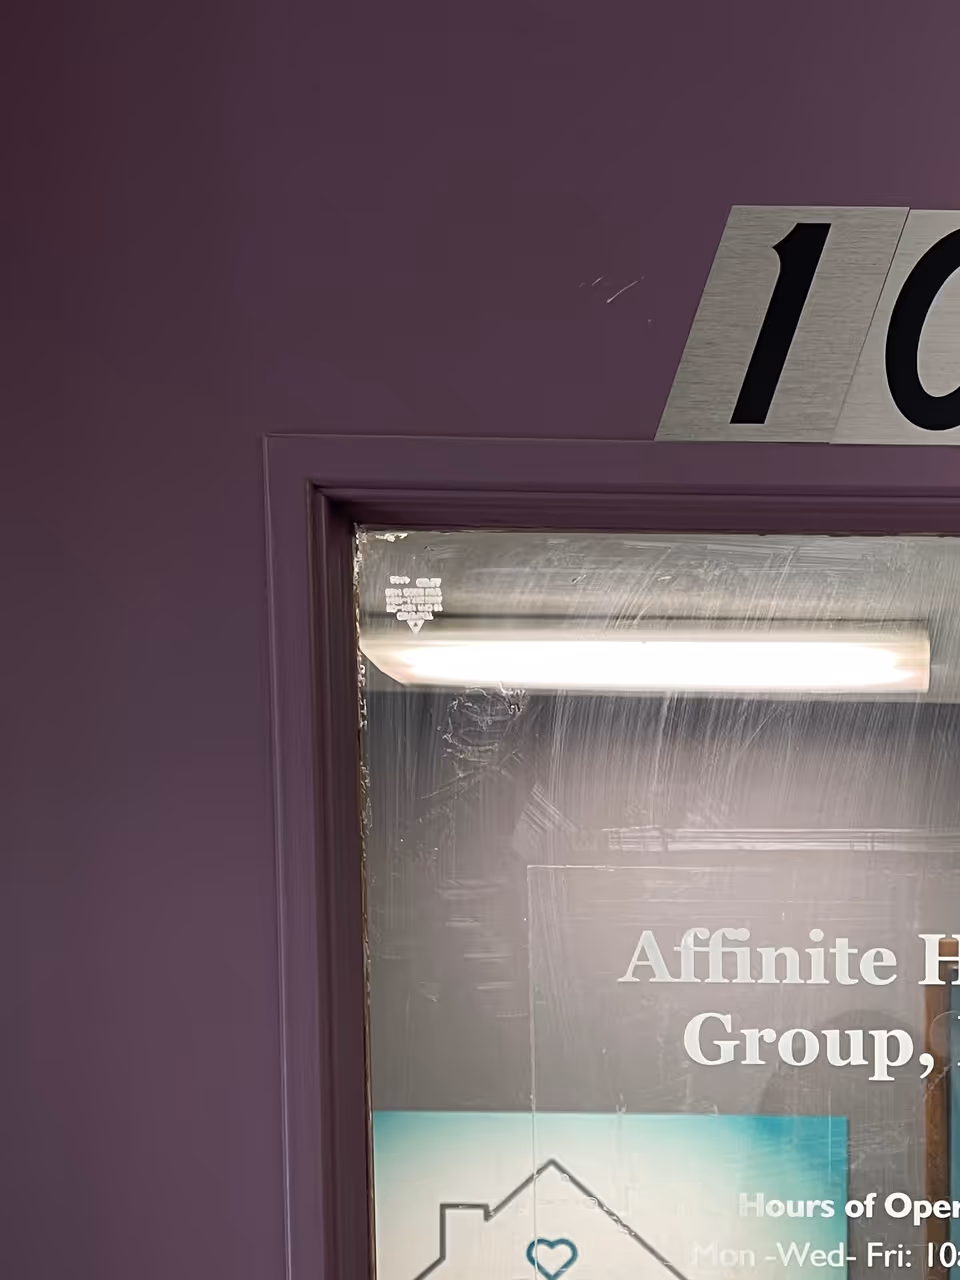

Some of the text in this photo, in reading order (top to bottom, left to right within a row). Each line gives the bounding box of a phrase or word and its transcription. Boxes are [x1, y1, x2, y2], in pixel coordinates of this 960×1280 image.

[617, 928, 898, 986] Affinite
[683, 1011, 934, 1081] Group,
[738, 1192, 836, 1219] Hours
[844, 1192, 877, 1219] of
[691, 1242, 755, 1267] Mon
[866, 1242, 913, 1268] Fri:
